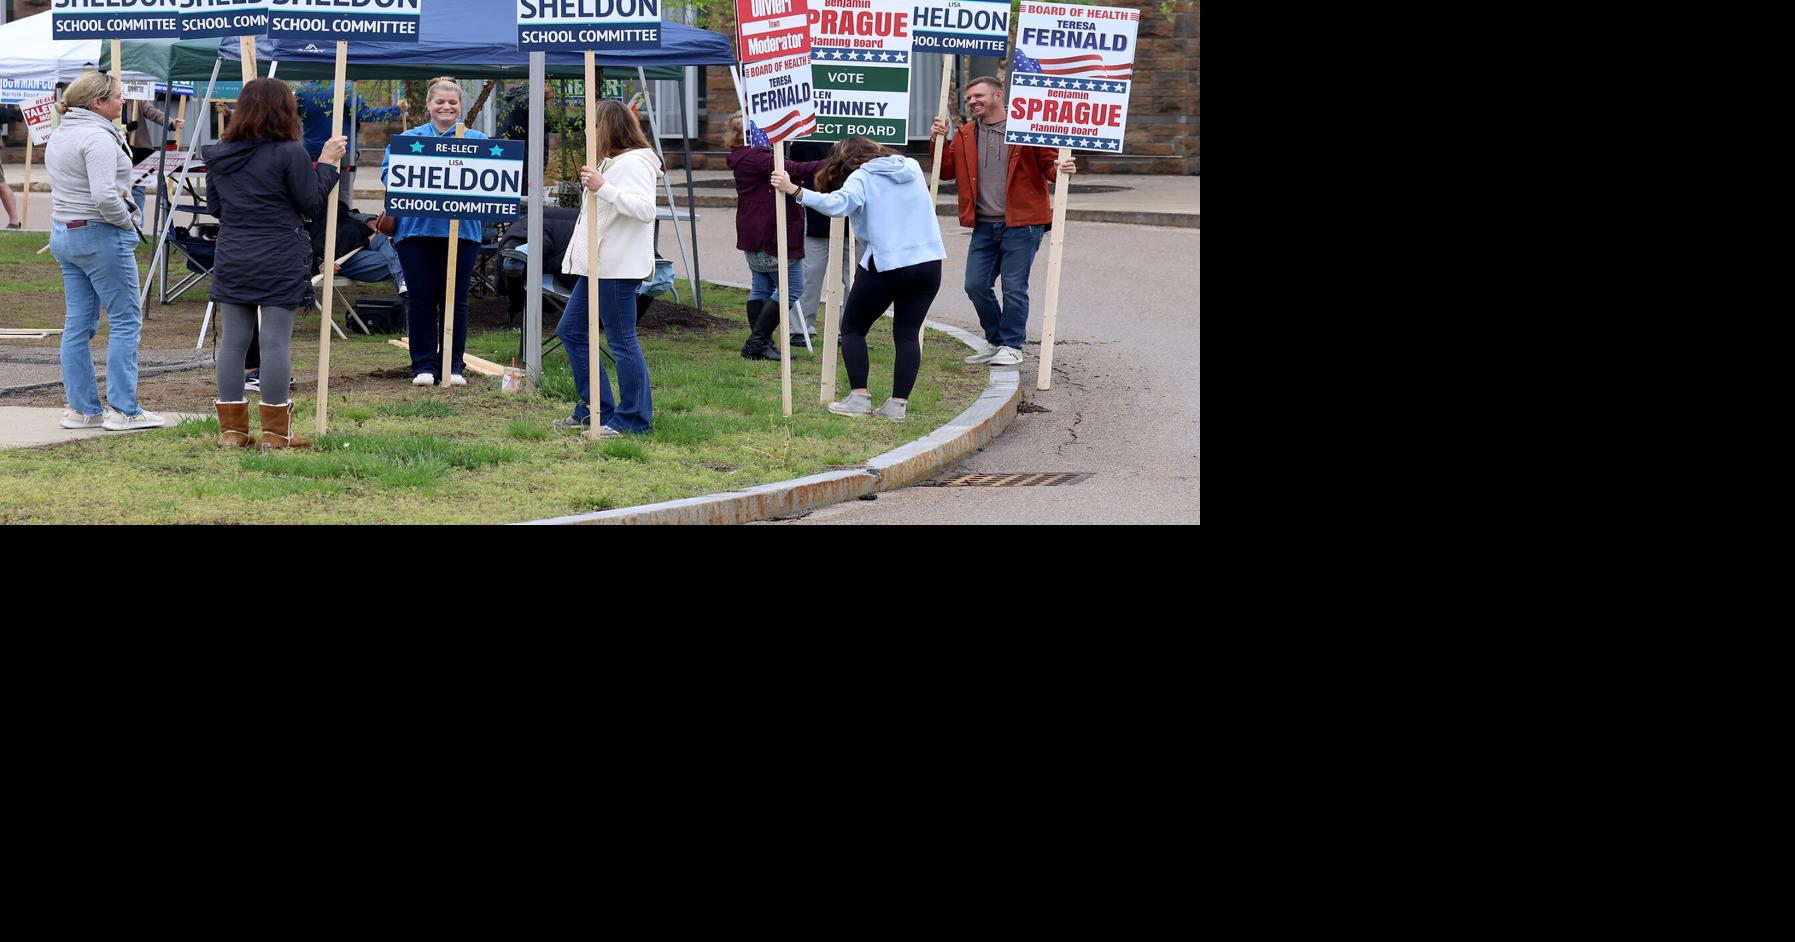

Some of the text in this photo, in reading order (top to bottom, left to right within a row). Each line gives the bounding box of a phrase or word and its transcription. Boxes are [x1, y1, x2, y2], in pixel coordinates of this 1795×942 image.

[520, 0, 657, 18] SHELDON
[825, 0, 871, 8] Benjamin
[913, 6, 1008, 31] HELDON
[1028, 5, 1128, 20] BOARD OF HEALTH
[56, 18, 176, 32] SCHOOL COMMITTEE
[182, 17, 231, 31] SCHOOL
[272, 17, 329, 32] SCHOOL
[332, 18, 416, 34] COMMITTEE
[807, 9, 908, 37] PRAGUE
[1057, 20, 1096, 31] TERESA
[522, 29, 657, 43] SCHOOL COMMITTEE
[853, 38, 883, 48] Board
[1022, 27, 1128, 52] FERNALD
[748, 33, 804, 56] Moderator
[912, 36, 1005, 51] HOOL COMMITTEE
[751, 56, 807, 77] BOARD OF HEALTH
[769, 74, 792, 88] TERESA
[828, 72, 864, 83] VOTE
[751, 82, 811, 114] FERNALD
[813, 91, 831, 99] LEN
[1047, 89, 1089, 100] Benjamin
[1010, 97, 1122, 127] SPRAGUE
[816, 123, 896, 136] ECT BOARD
[1030, 123, 1098, 136] Planning Board
[436, 143, 479, 154] RE-ELECT
[391, 164, 519, 193] SHELDON
[390, 198, 517, 215] SCHOOL COMMITTEE
